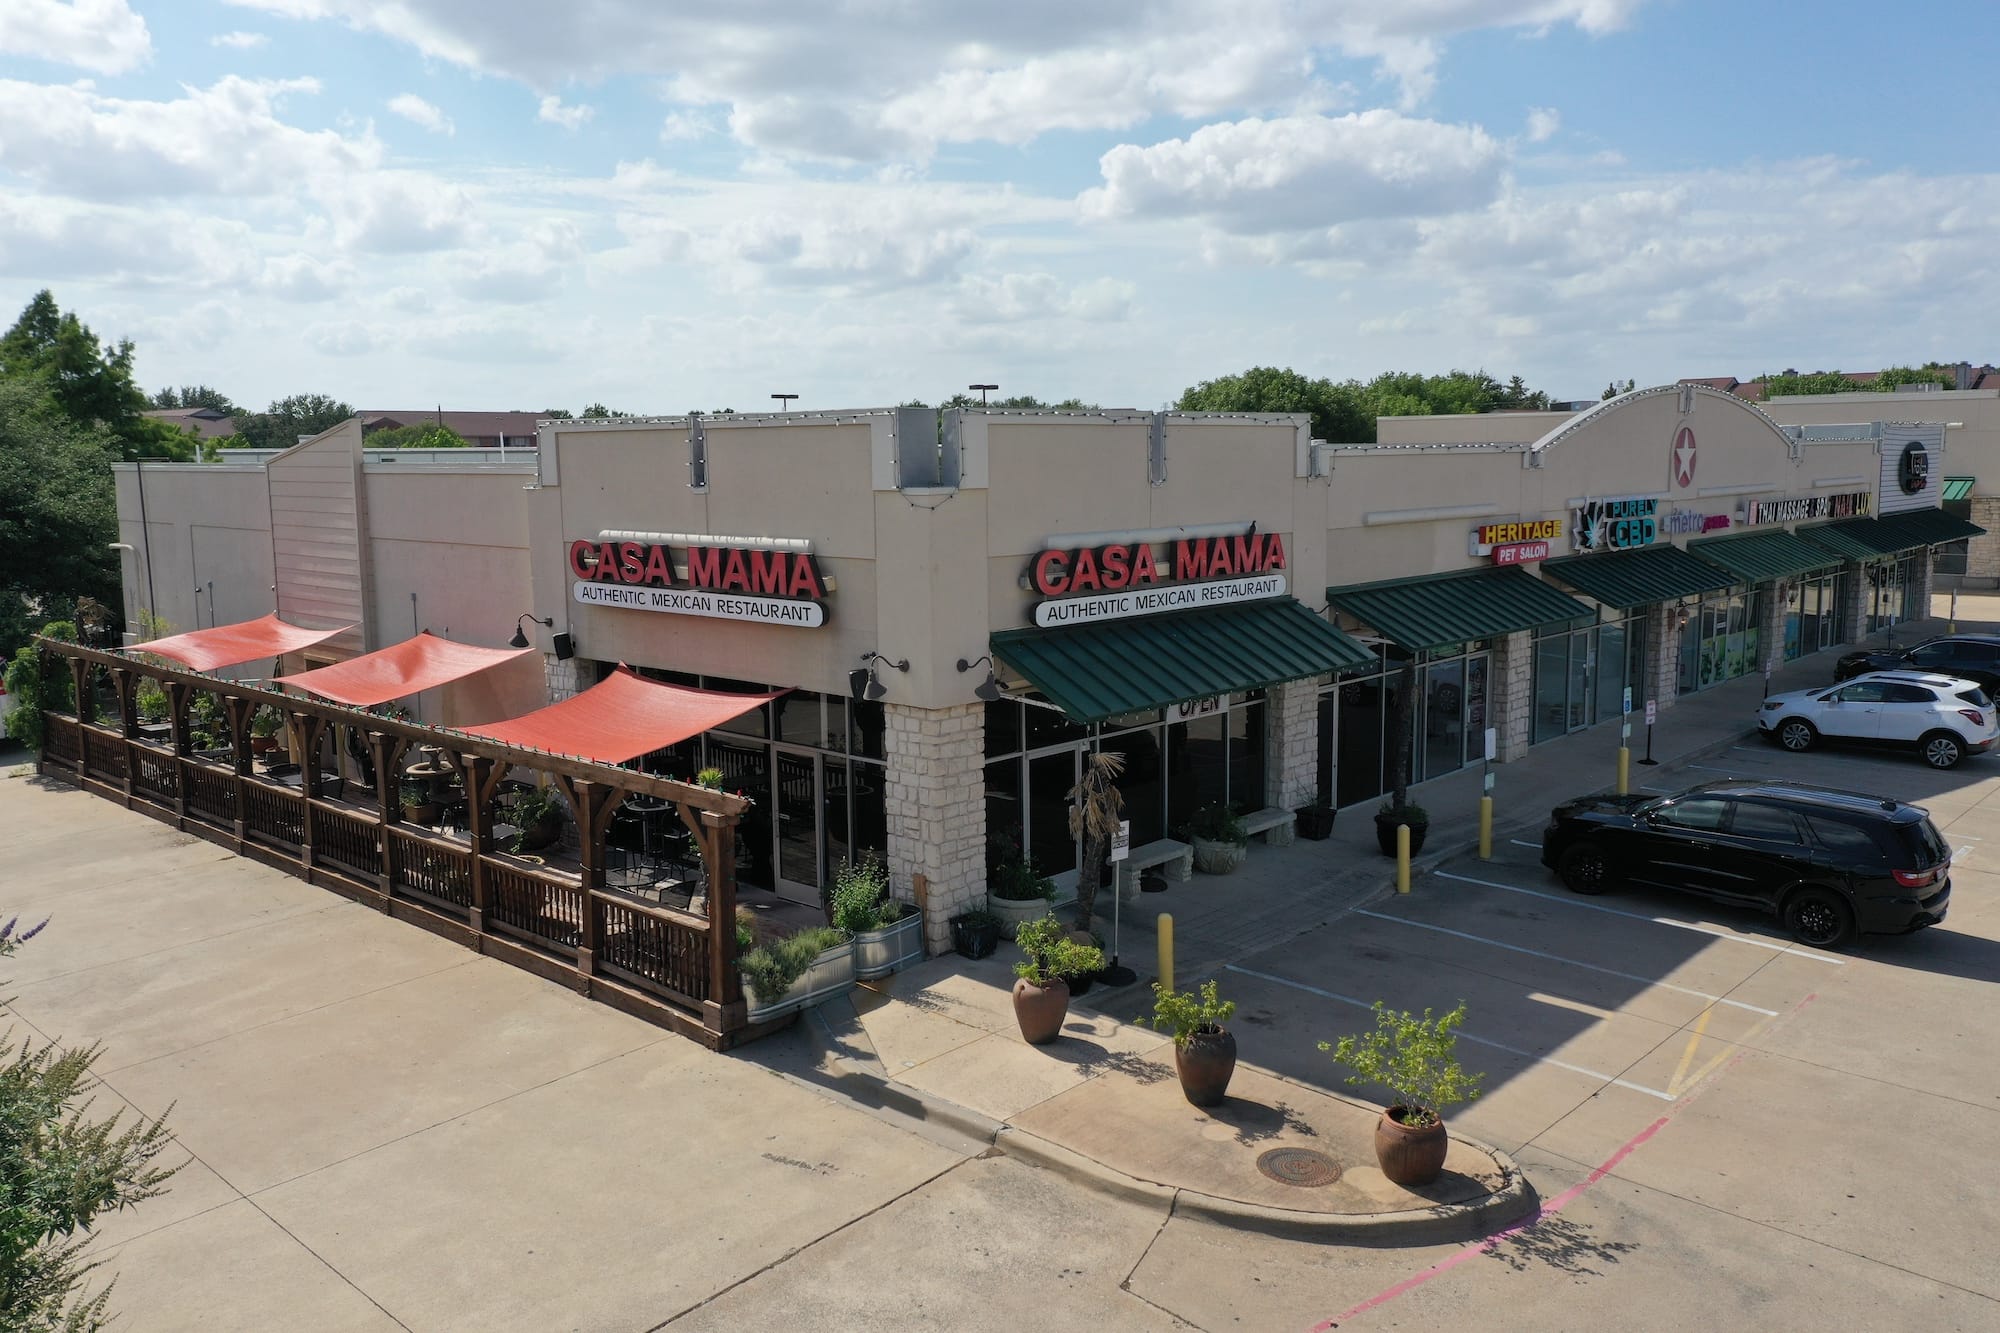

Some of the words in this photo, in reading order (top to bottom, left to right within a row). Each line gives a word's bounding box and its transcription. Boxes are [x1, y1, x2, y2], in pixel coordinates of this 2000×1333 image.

[1613, 498, 1658, 518] PURELY
[1759, 503, 1776, 525] THAI
[1777, 499, 1809, 522] MASSAGE
[1816, 497, 1828, 518] SPA
[1856, 492, 1872, 515] LUX
[1485, 519, 1562, 544] HERITAGE
[1615, 518, 1657, 548] CBD
[1670, 509, 1703, 534] metro
[1036, 543, 1159, 596] CASA
[1176, 533, 1287, 579] MAMA
[1499, 548, 1517, 562] PET
[1519, 545, 1546, 560] SALON
[569, 539, 673, 586] CASA
[687, 545, 823, 599] MAMA
[582, 586, 646, 606] AUTHENTIC
[651, 592, 711, 611] MEXICAN
[717, 599, 811, 622] RESTAURANT
[1047, 598, 1129, 622] AUTHENTIC
[1135, 588, 1196, 611] MEXICAN
[1201, 579, 1278, 601] RESTAURANT
